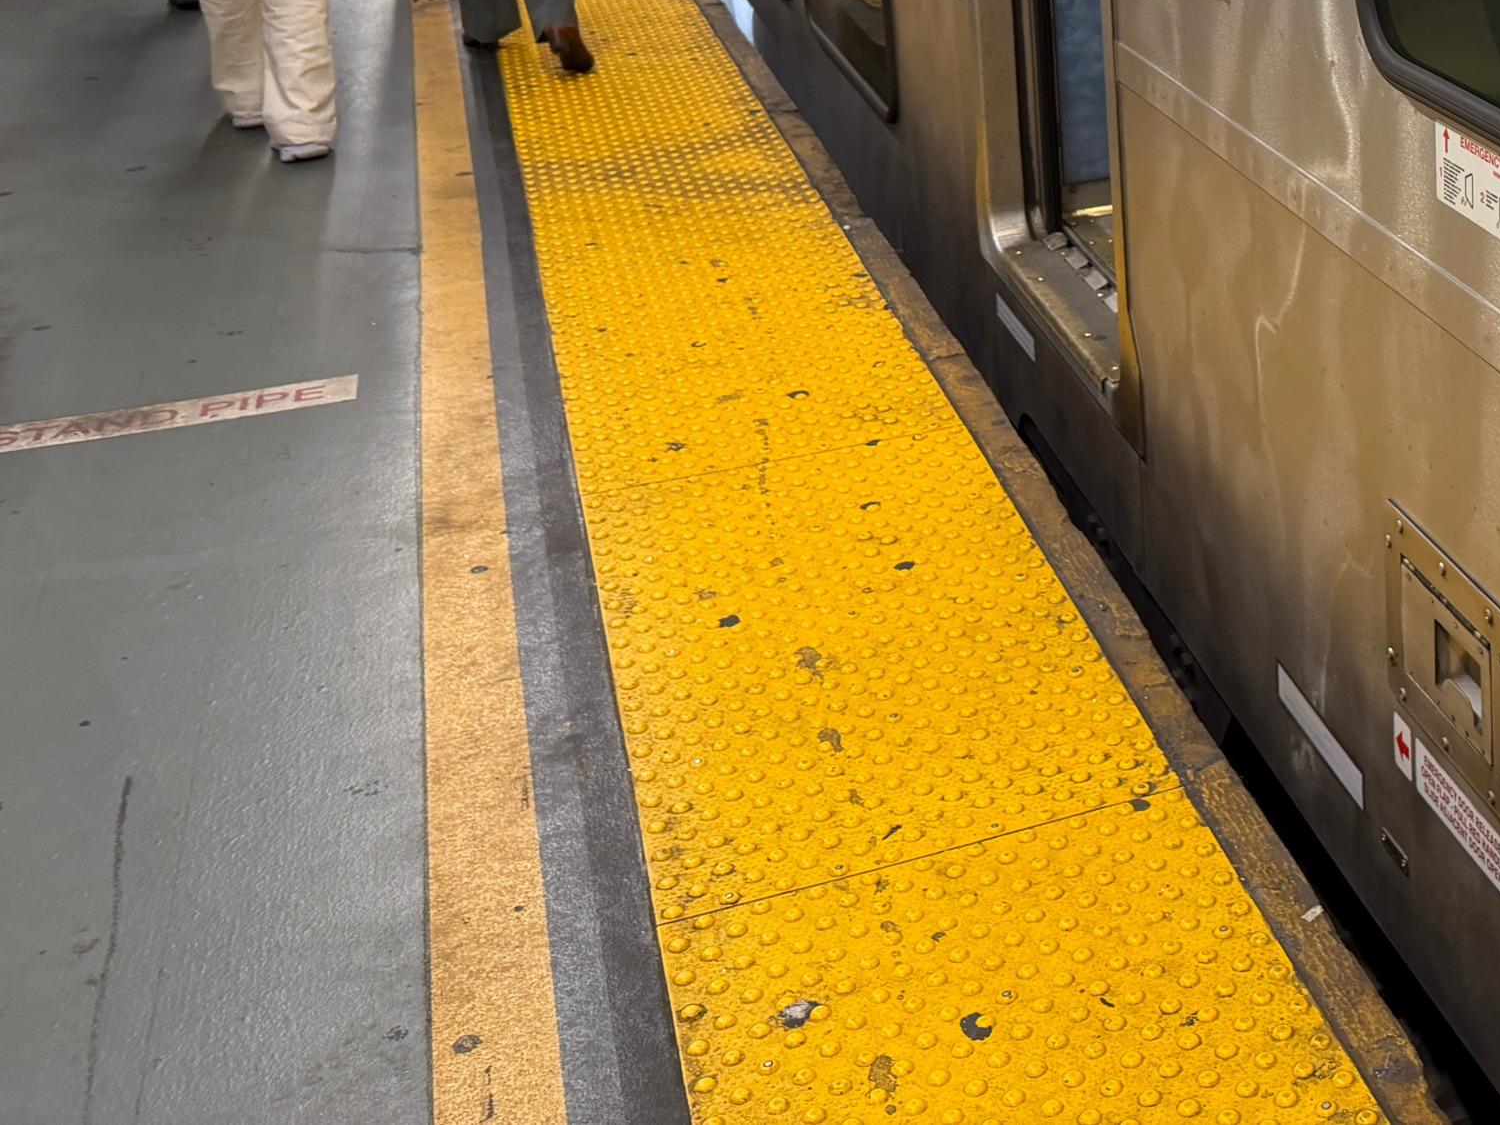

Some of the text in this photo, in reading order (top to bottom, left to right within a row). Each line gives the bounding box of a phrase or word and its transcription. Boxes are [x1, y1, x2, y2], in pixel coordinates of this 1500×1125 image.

[1480, 191, 1485, 203] 2
[199, 385, 327, 418] PIPE
[1421, 765, 1436, 789] OPEN
[1436, 783, 1450, 805] FLAP
[1454, 804, 1468, 830] PULL
[1468, 823, 1481, 843] RED
[1424, 755, 1457, 801] EMERGENCY
[1458, 796, 1474, 822] DOOR
[1424, 782, 1439, 807] SLIDE
[1468, 836, 1486, 863] DOOR
